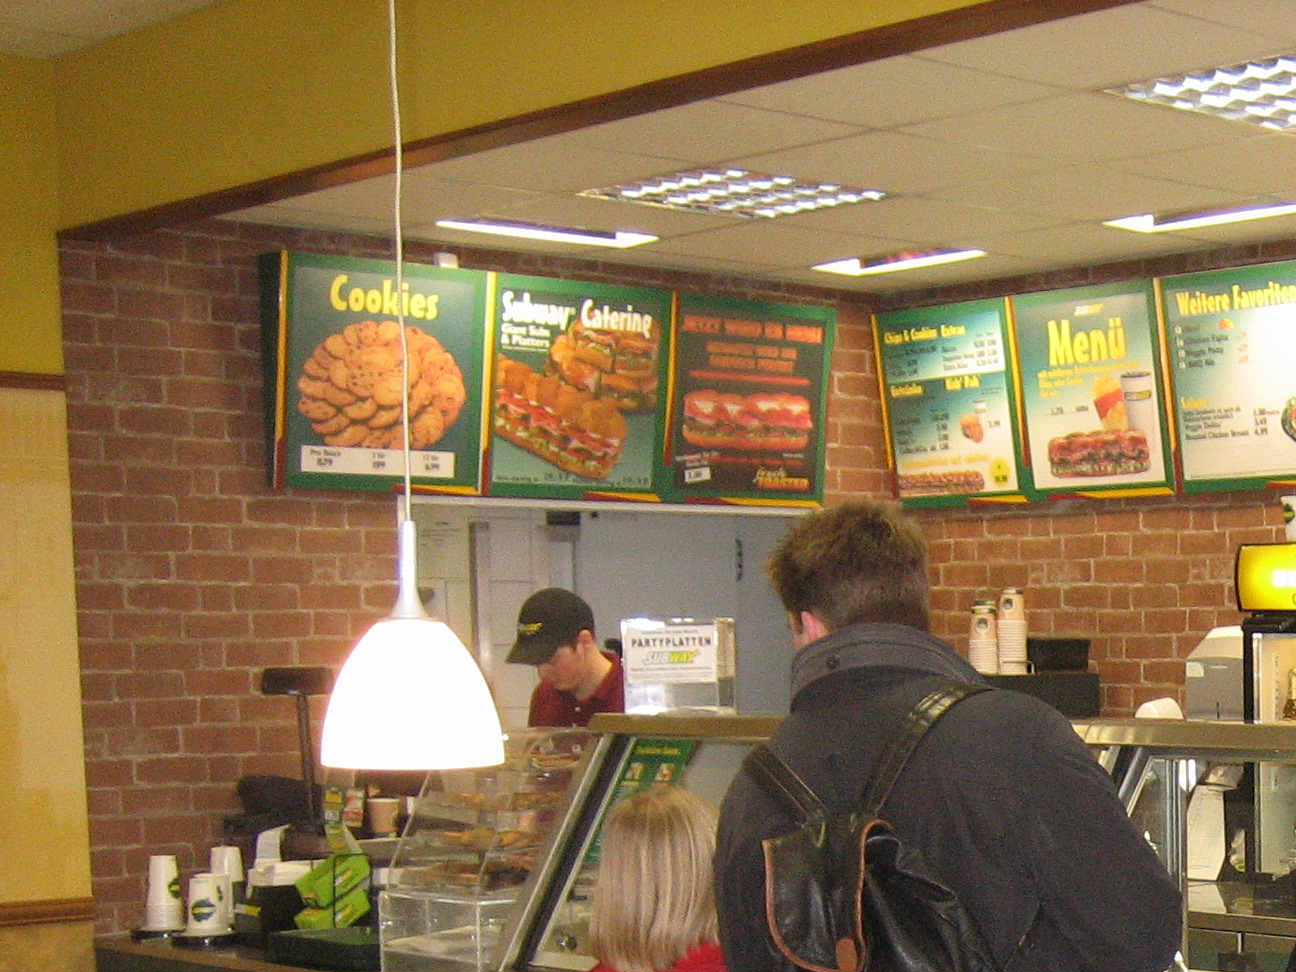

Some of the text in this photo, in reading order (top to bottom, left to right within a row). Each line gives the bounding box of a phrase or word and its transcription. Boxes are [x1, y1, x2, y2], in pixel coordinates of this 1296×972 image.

[330, 274, 440, 320] Cookies
[1175, 291, 1230, 316] Weitere
[581, 299, 653, 339] Catering
[1047, 316, 1126, 367] Menü
[630, 637, 712, 648] PARTYPLATTEN
[642, 650, 701, 666] SUBWAY
